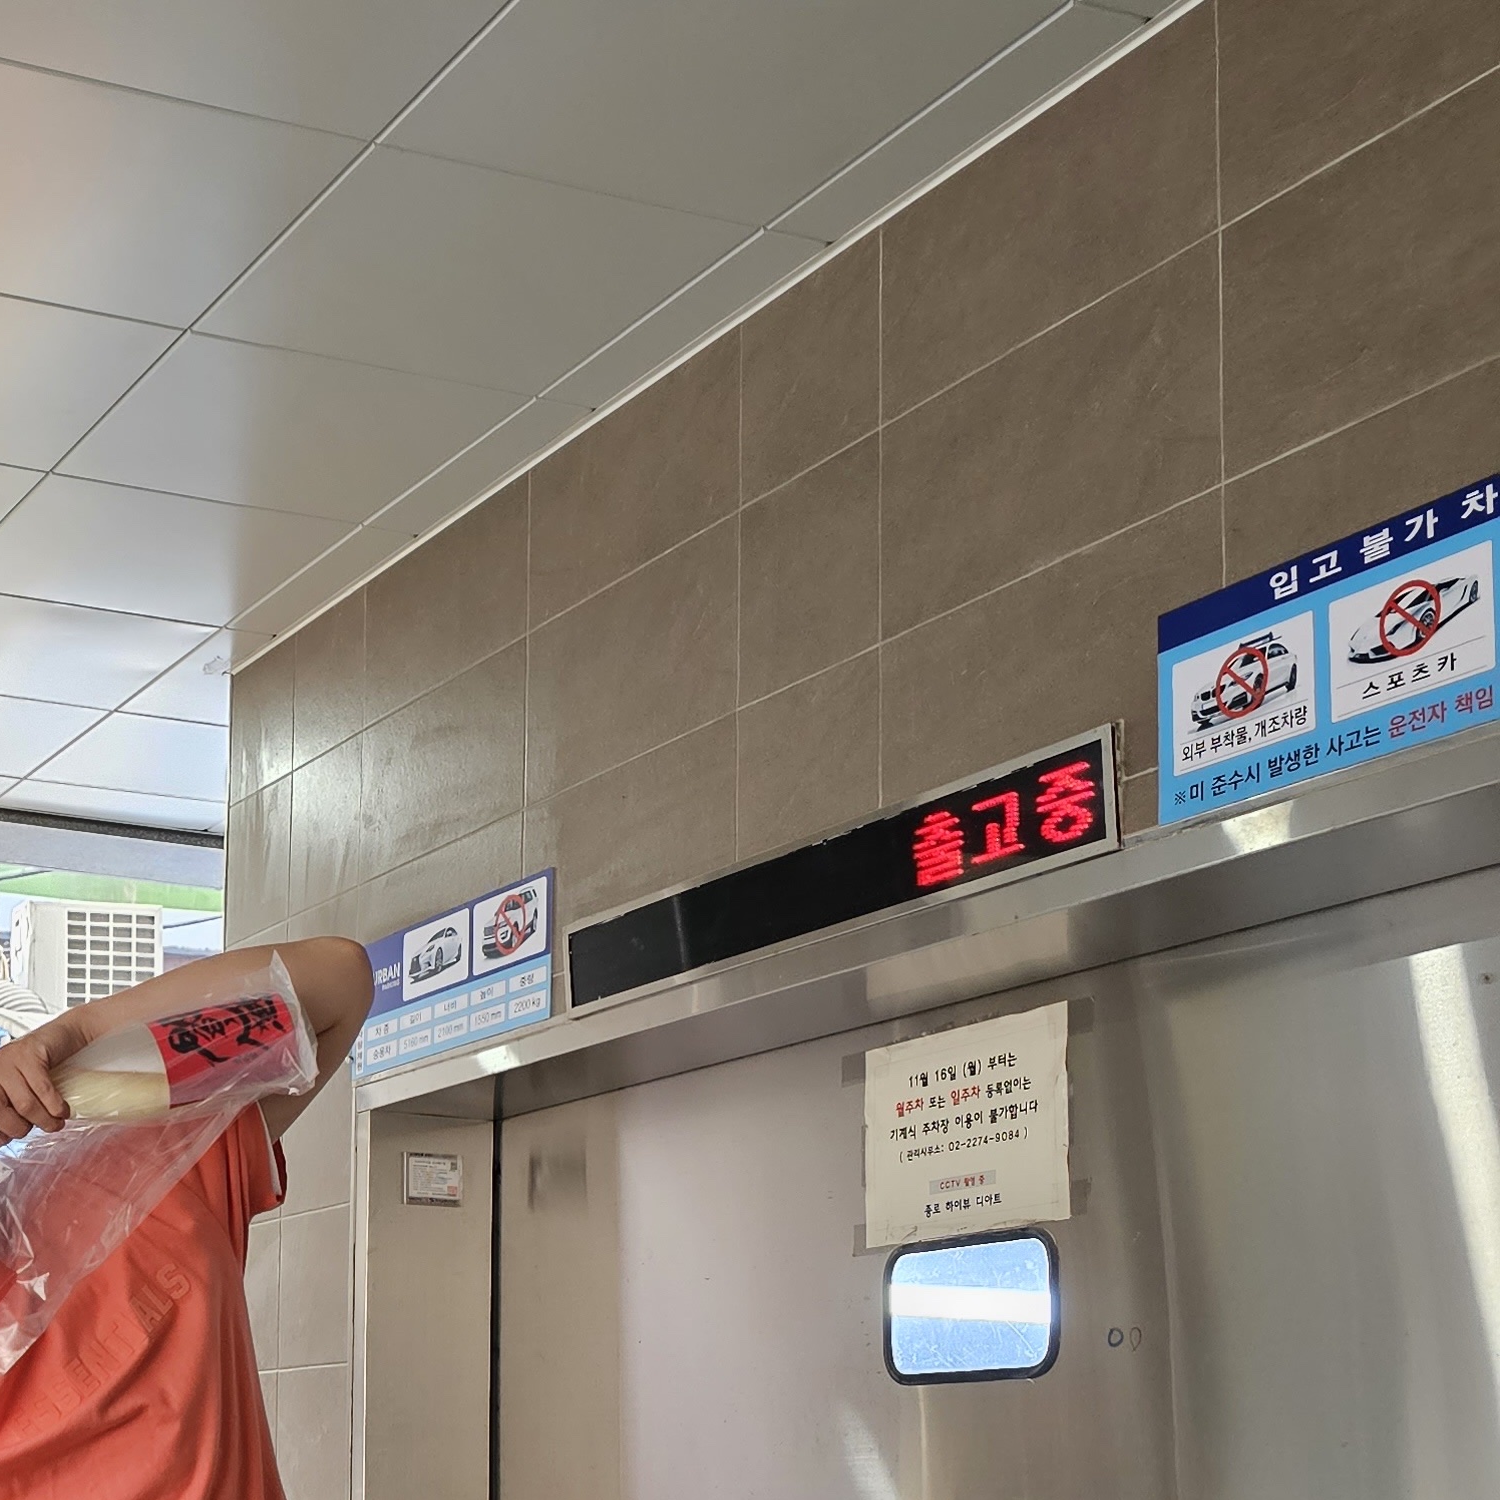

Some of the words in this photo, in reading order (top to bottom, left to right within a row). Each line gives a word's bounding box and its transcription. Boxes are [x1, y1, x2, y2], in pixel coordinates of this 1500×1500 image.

[1182, 740, 1206, 761] 외부
[1210, 726, 1251, 753] 부착물,
[1255, 706, 1308, 738] 개조차량
[1211, 763, 1260, 796] 준수시
[1268, 743, 1320, 778] 발생한
[1326, 726, 1382, 758] 사고는
[1388, 701, 1447, 738] 운전자
[1454, 685, 1493, 714] 책임
[912, 761, 1095, 886] 출고중
[909, 1072, 928, 1088] 11월
[935, 1065, 957, 1082] 16일
[963, 1059, 982, 1078] (월)
[987, 1052, 1017, 1070] 부터는
[895, 1098, 924, 1118] 월주차
[929, 1095, 946, 1109] 또는
[950, 1085, 981, 1106] 일주차
[985, 1076, 1032, 1099] 등록없이는
[890, 1125, 917, 1141] 기계식
[922, 1118, 949, 1136] 주차장
[955, 1111, 983, 1129] 이용이
[988, 1099, 1039, 1125] 불가합니다
[948, 1129, 1020, 1152] 02-2274-9084
[924, 1203, 941, 1218] 종로
[945, 1198, 971, 1213] 하이뷰
[976, 1193, 1002, 1208] 디아트
[940, 1179, 960, 1190] CCTV
